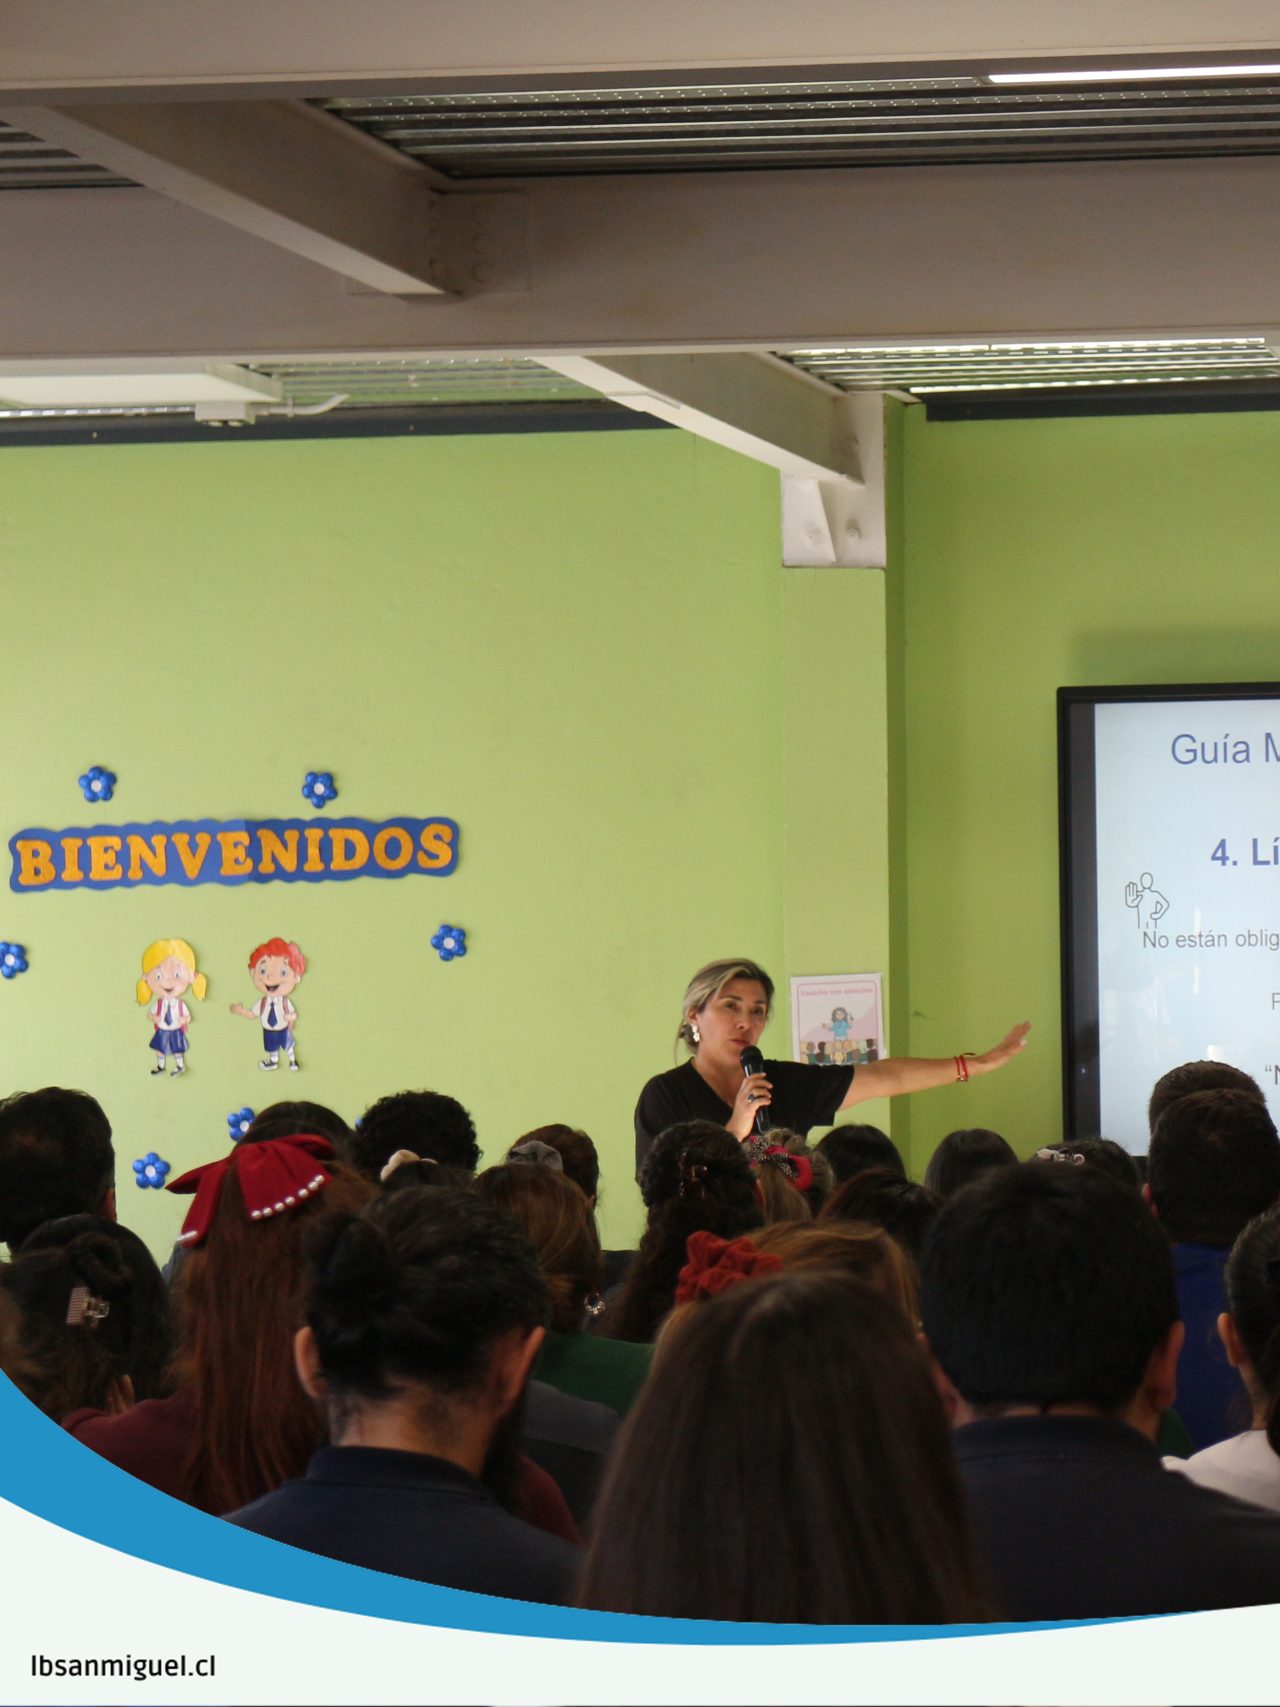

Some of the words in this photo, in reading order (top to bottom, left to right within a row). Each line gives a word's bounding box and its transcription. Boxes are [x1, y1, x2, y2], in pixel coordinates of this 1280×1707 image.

[1171, 733, 1252, 765] Guía
[16, 822, 454, 886] BIENVENIDOS
[1210, 838, 1239, 867] 4.
[1142, 930, 1169, 949] No
[1175, 929, 1228, 948] están
